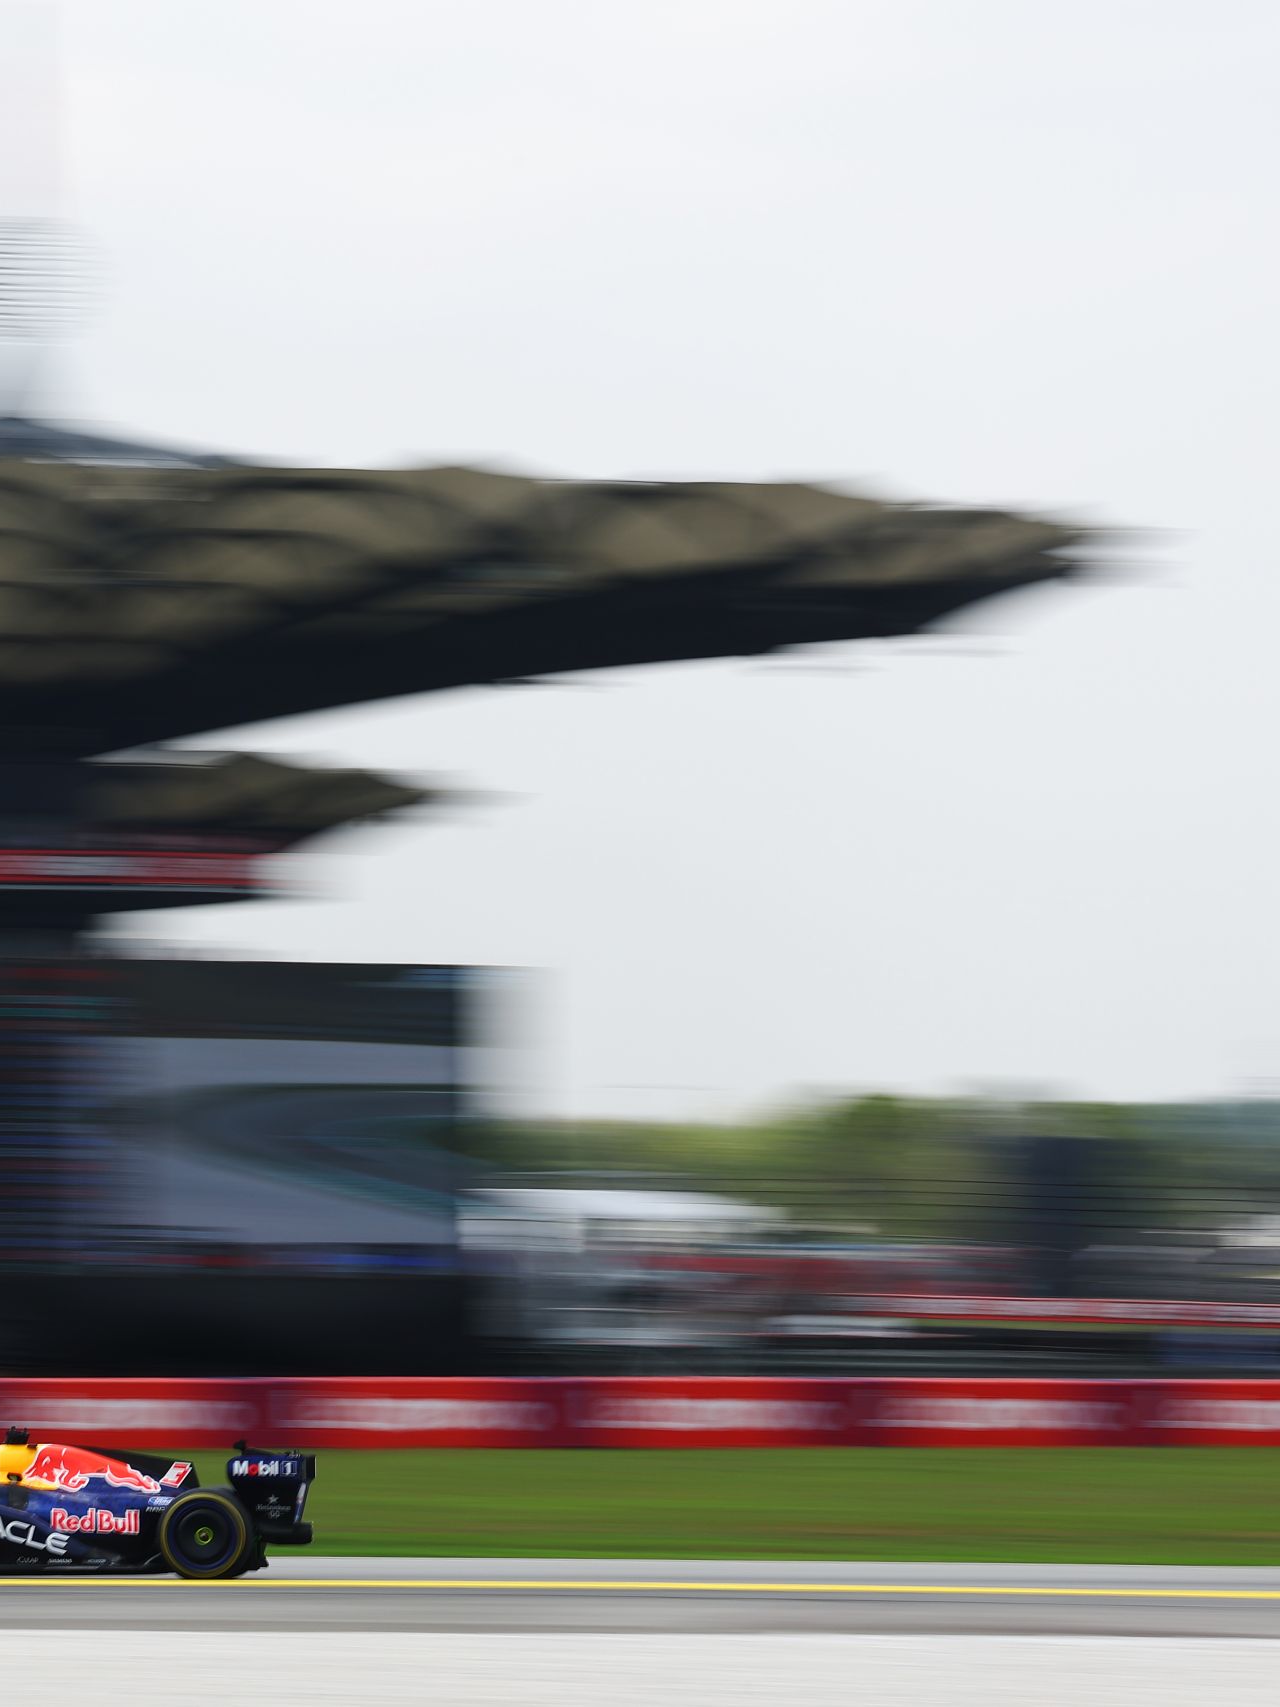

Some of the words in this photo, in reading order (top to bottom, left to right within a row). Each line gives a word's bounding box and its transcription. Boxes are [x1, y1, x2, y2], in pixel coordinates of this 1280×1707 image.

[232, 1460, 279, 1477] Mobil
[284, 1461, 293, 1476] 1
[50, 1507, 96, 1533] Red
[97, 1508, 140, 1535] Bull
